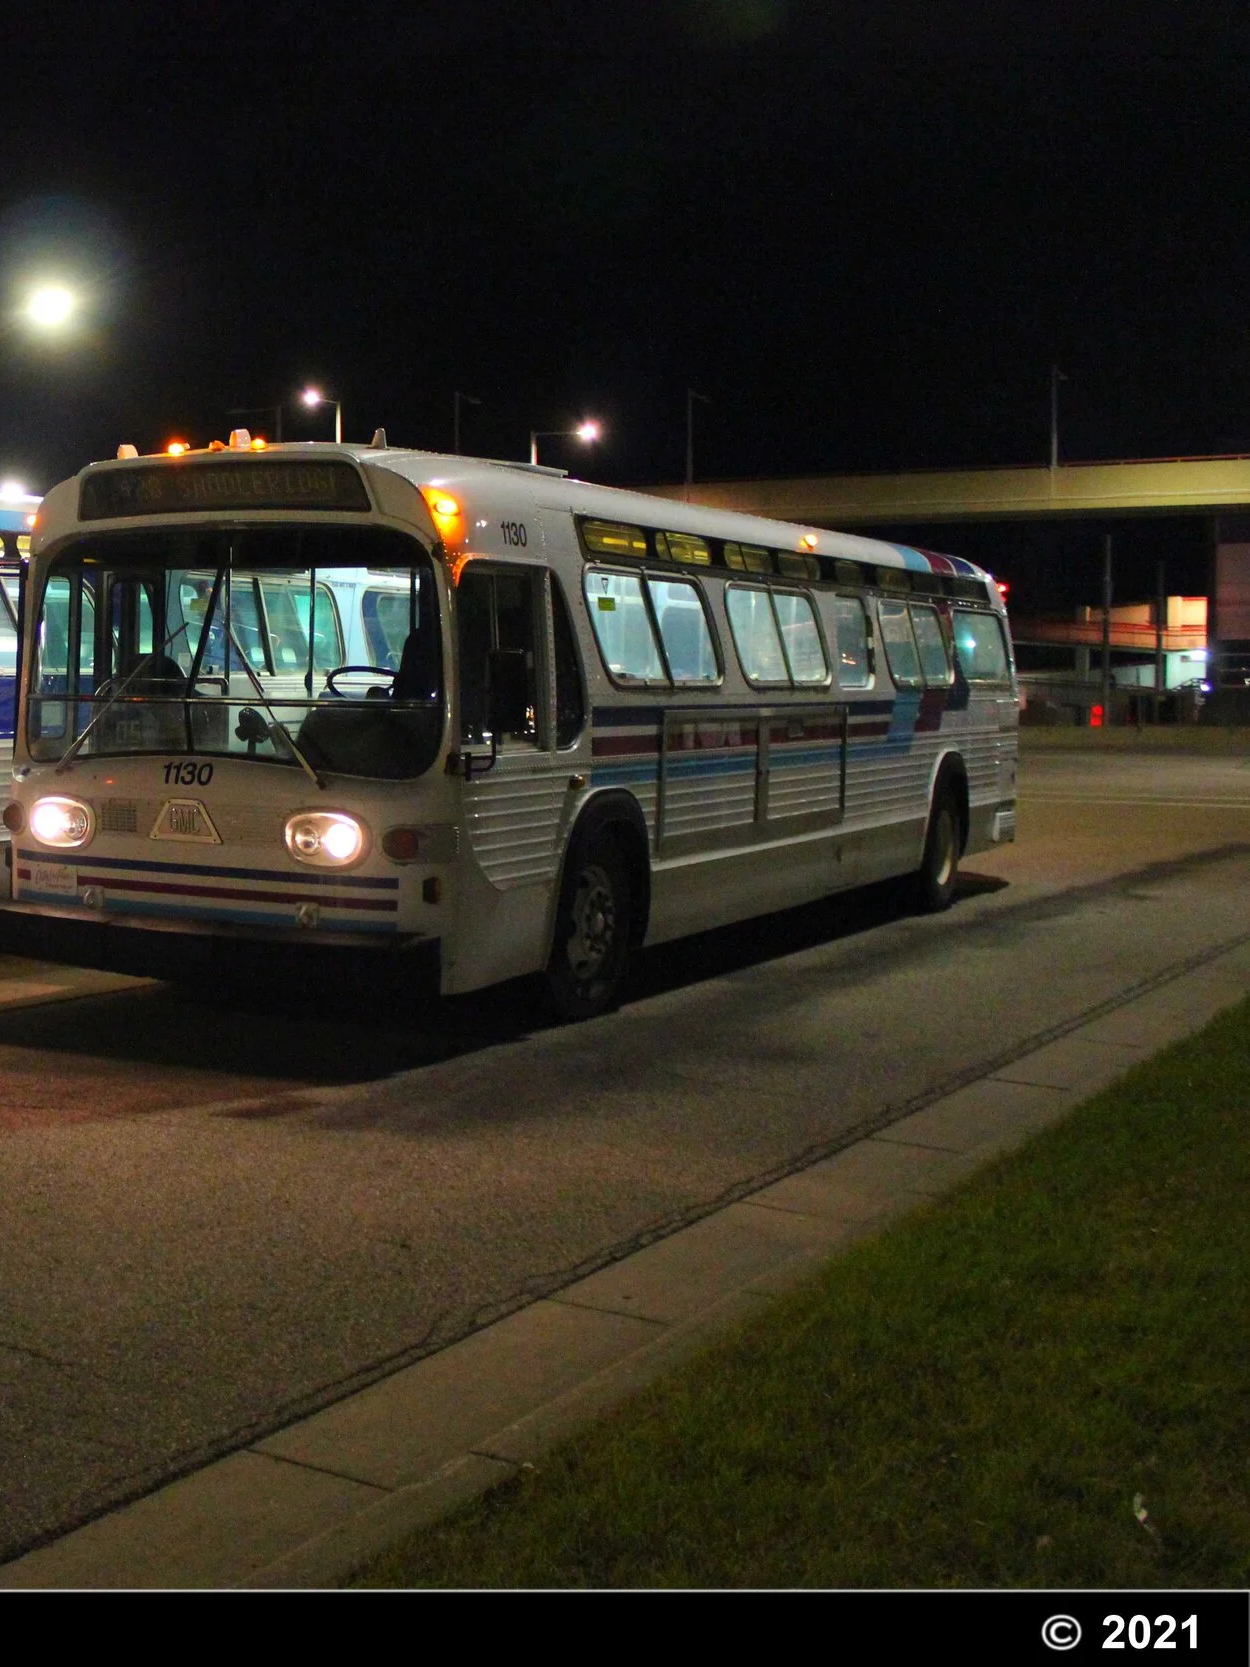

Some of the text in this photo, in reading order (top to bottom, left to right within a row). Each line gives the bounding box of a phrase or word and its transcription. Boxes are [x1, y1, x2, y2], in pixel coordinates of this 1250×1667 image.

[500, 520, 528, 548] 1130
[163, 761, 215, 787] 1130
[168, 807, 202, 834] GMC
